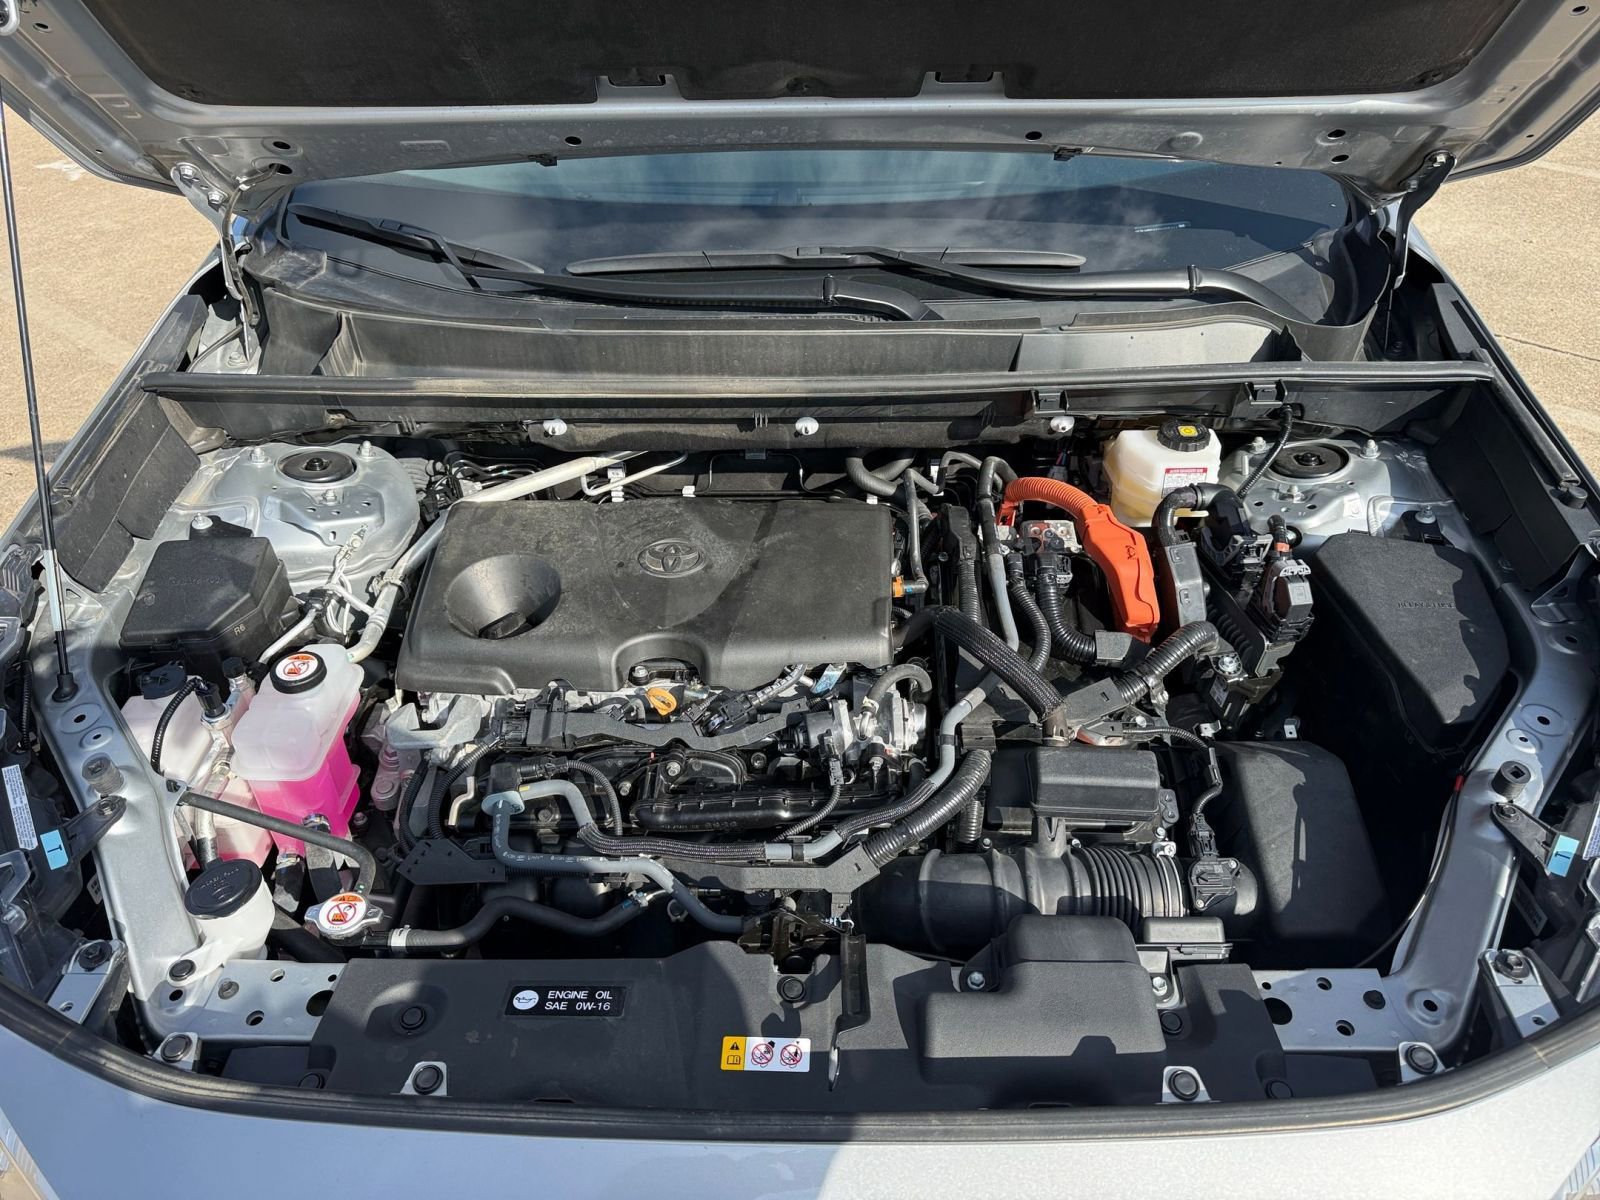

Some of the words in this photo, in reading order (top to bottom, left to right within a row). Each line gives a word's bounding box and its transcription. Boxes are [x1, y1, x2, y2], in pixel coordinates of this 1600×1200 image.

[547, 990, 589, 999] ENGINE
[595, 990, 613, 999] OIL
[544, 1001, 569, 1010] SAE
[575, 1001, 611, 1011] 0W-16
